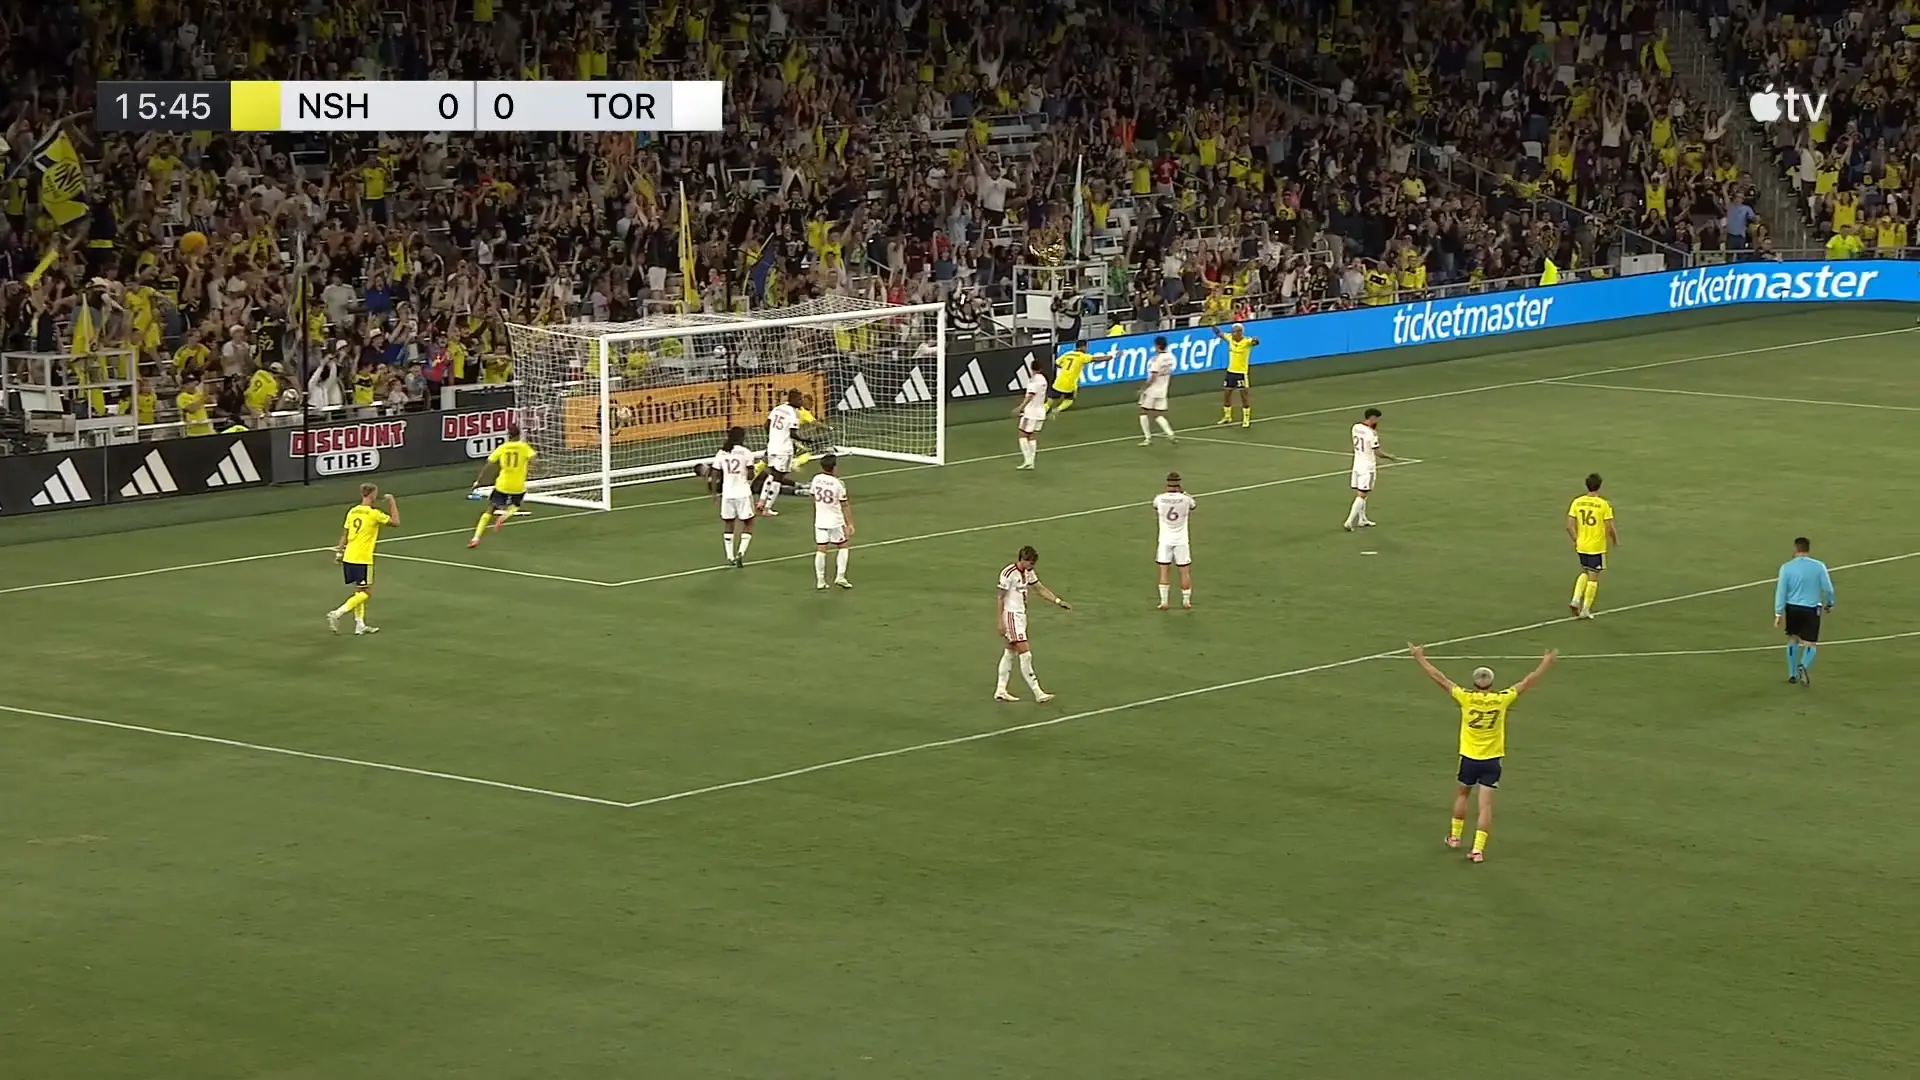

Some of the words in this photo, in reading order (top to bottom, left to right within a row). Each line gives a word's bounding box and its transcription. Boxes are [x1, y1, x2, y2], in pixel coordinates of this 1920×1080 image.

[1669, 265, 1879, 309] ticketmaster
[1392, 295, 1554, 345] ticketmaster
[1066, 357, 1075, 371] 7
[772, 414, 785, 431] 15
[290, 420, 405, 457] DISCOUNT
[472, 436, 506, 453] TIR
[1354, 435, 1365, 453] 21
[322, 451, 372, 471] TIRE
[505, 452, 519, 468] 11
[724, 458, 741, 475] 12
[814, 486, 834, 504] 38
[1166, 506, 1179, 521] 6
[1579, 509, 1597, 526] 16
[353, 517, 362, 534] 9
[1468, 709, 1500, 729] 27
